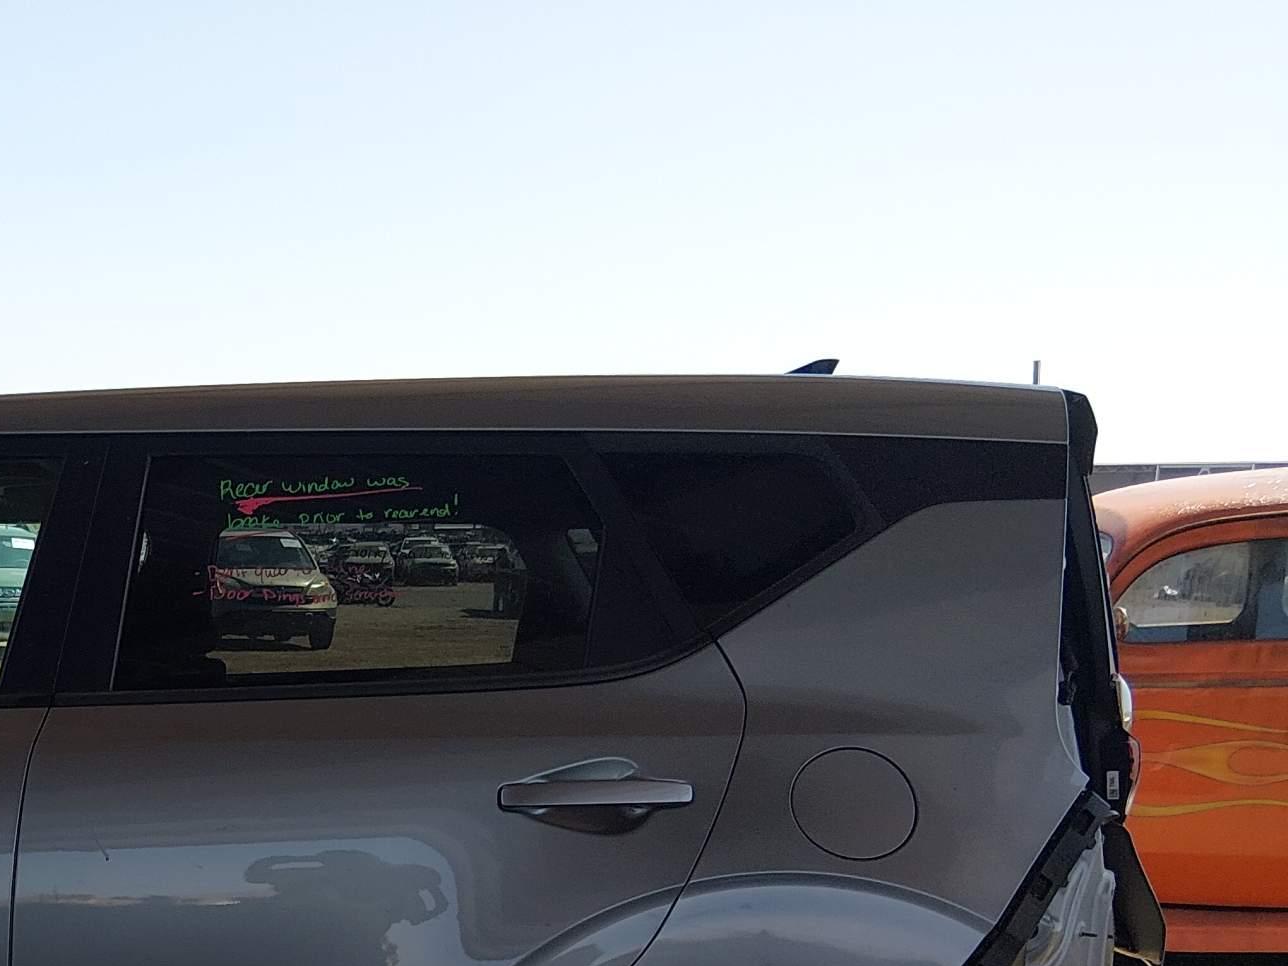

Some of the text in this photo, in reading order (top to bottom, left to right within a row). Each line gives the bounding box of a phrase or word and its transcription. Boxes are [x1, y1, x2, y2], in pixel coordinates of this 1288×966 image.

[219, 476, 410, 500] Rear window was
[298, 512, 345, 527] prior
[357, 509, 374, 520] to
